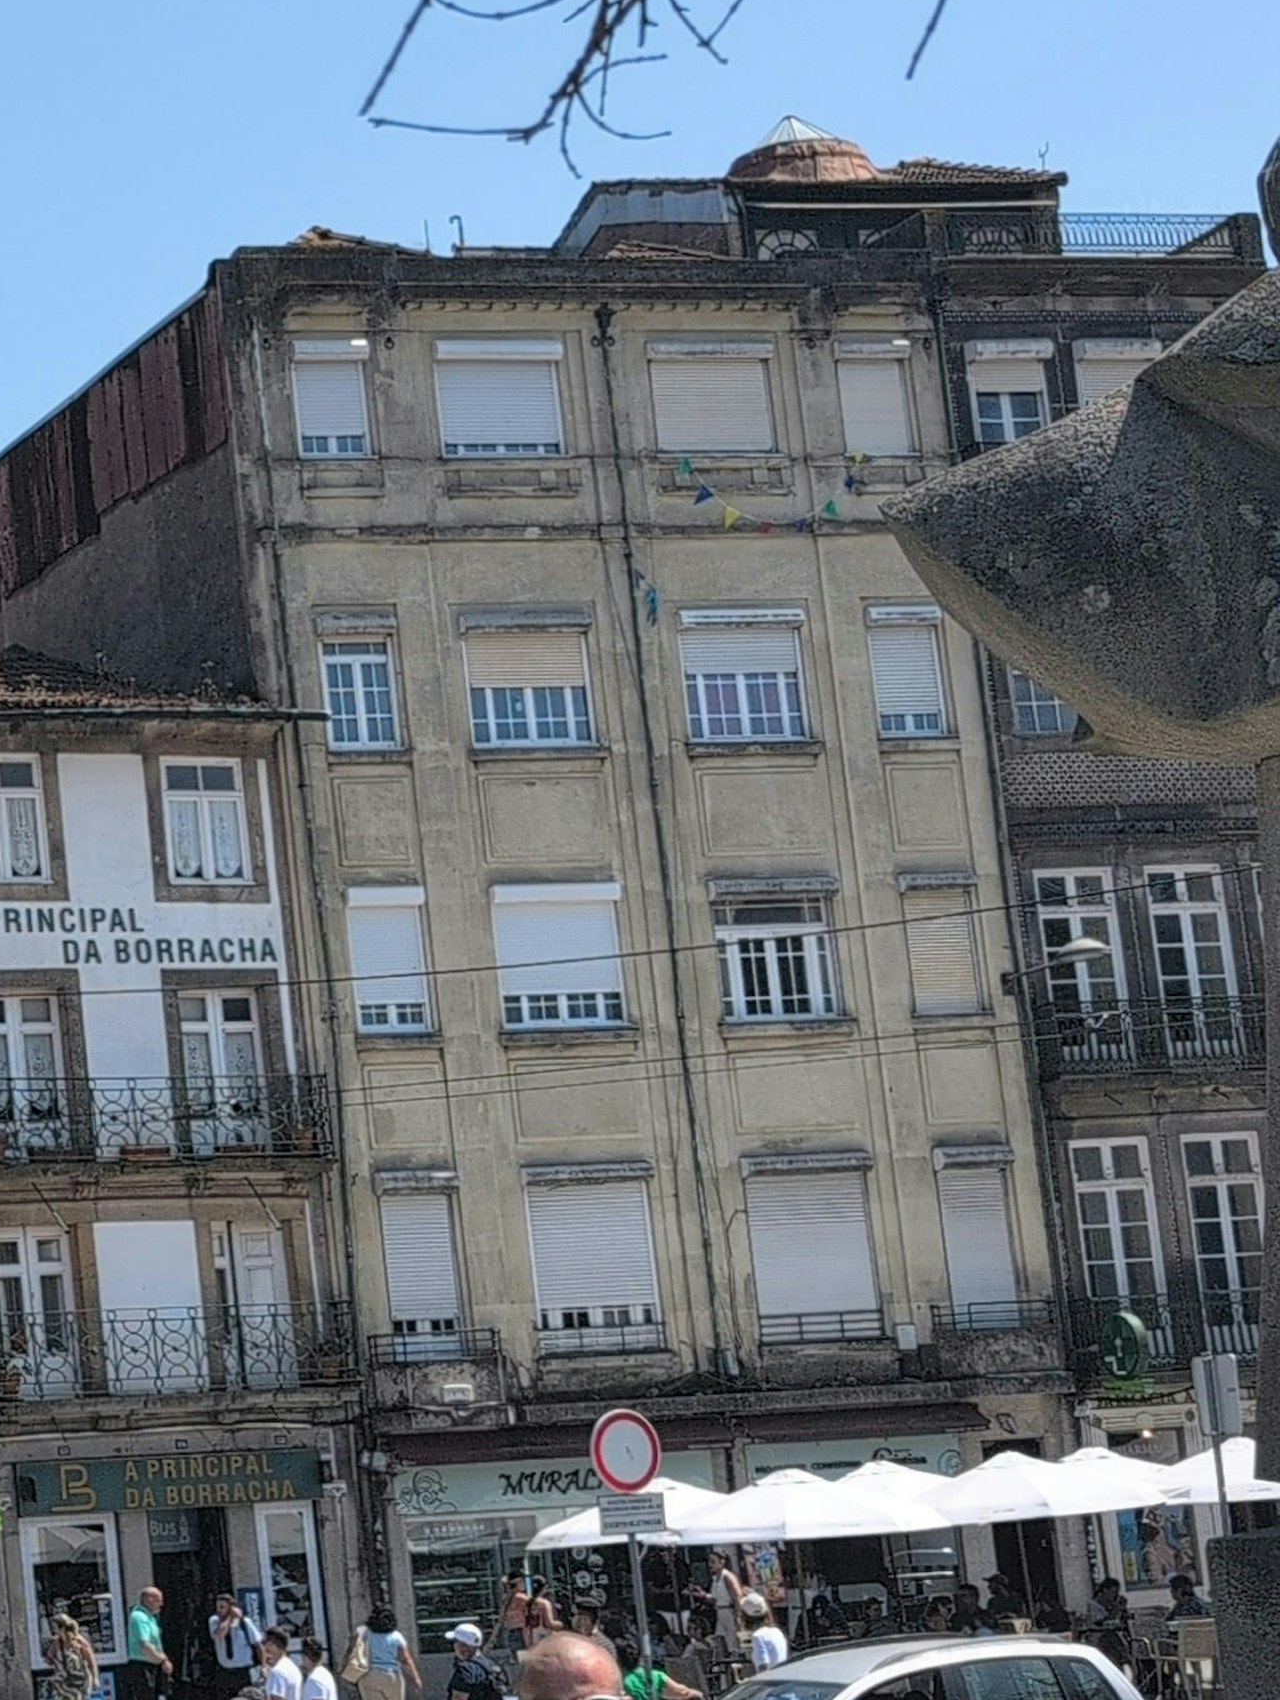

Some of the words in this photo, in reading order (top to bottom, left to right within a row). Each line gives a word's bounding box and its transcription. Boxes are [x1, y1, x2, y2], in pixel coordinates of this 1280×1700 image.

[62, 940, 102, 964] DA
[115, 938, 278, 965] BORRACHA
[124, 1460, 139, 1481] A
[146, 1454, 274, 1479] PRINCIPAL
[125, 1487, 156, 1508] DA
[166, 1479, 296, 1506] BORRACHA
